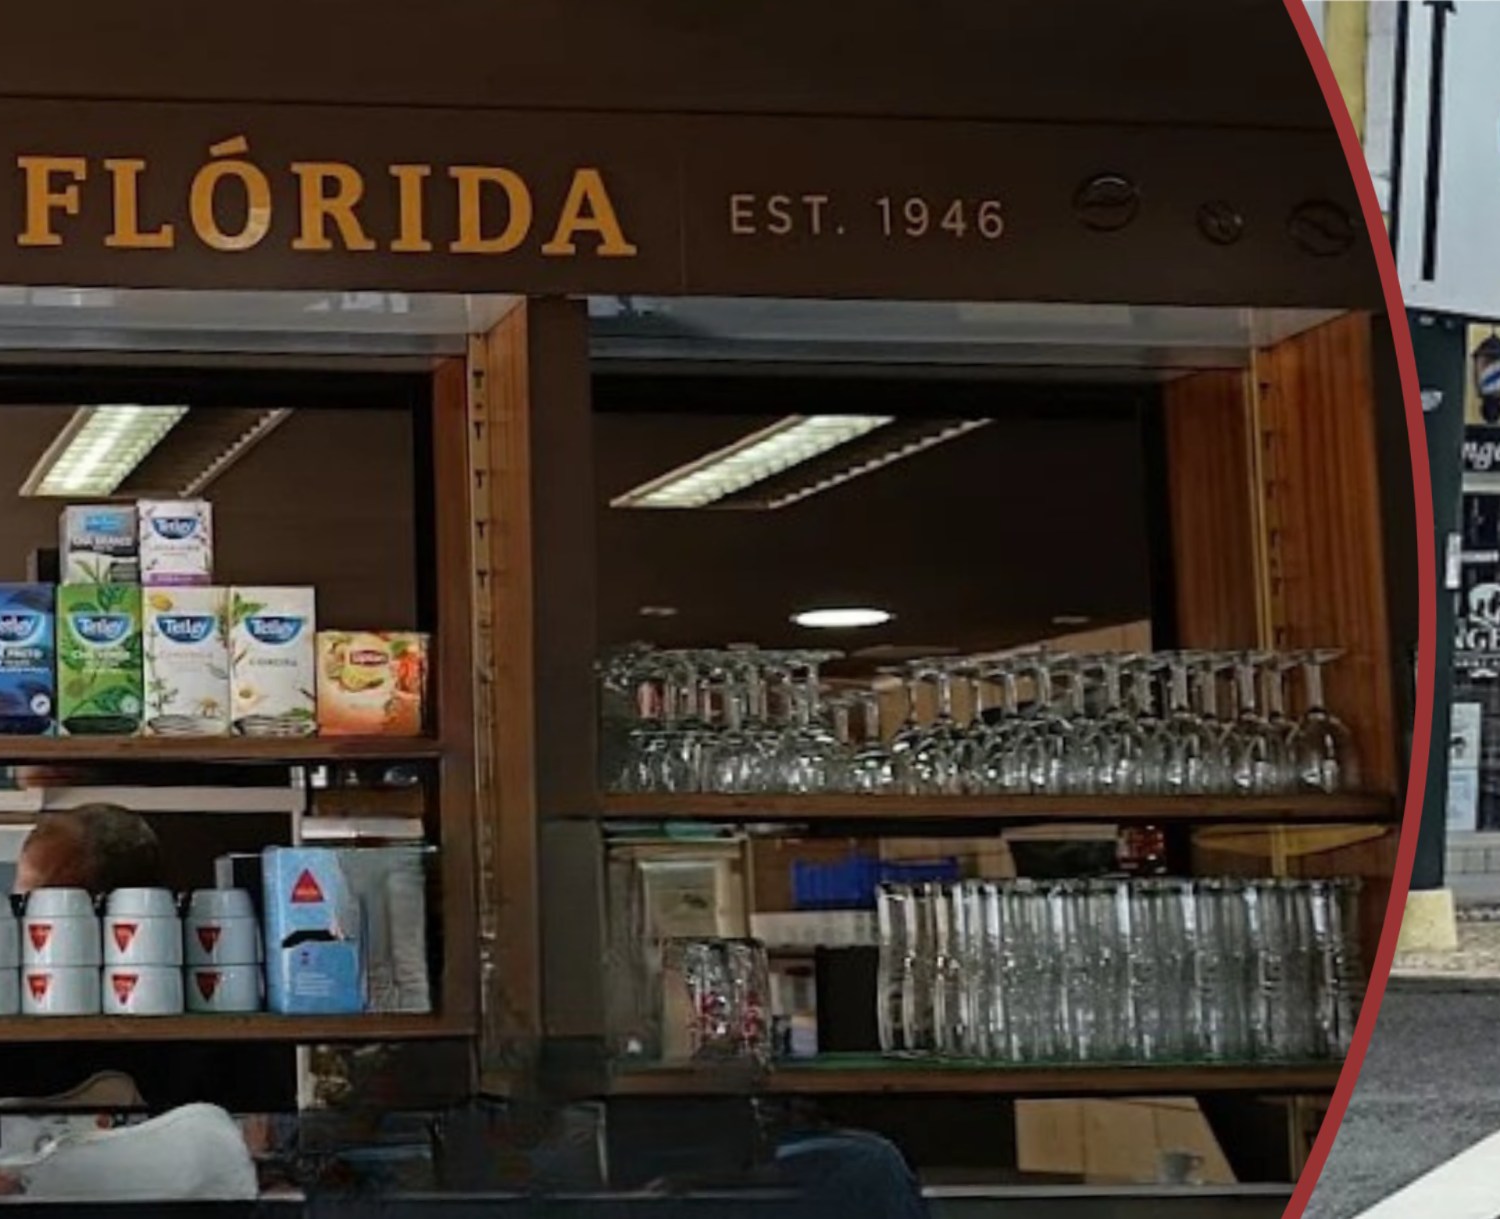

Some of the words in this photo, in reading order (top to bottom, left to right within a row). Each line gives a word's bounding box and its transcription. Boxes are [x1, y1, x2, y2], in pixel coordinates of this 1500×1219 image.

[17, 135, 637, 256] FLÓRIDA
[730, 194, 845, 234] EST.
[877, 197, 1004, 239] 1946
[156, 518, 194, 533] Tetley
[78, 617, 124, 638] Tetley
[164, 618, 208, 638] Tetley
[250, 619, 296, 637] Tetley
